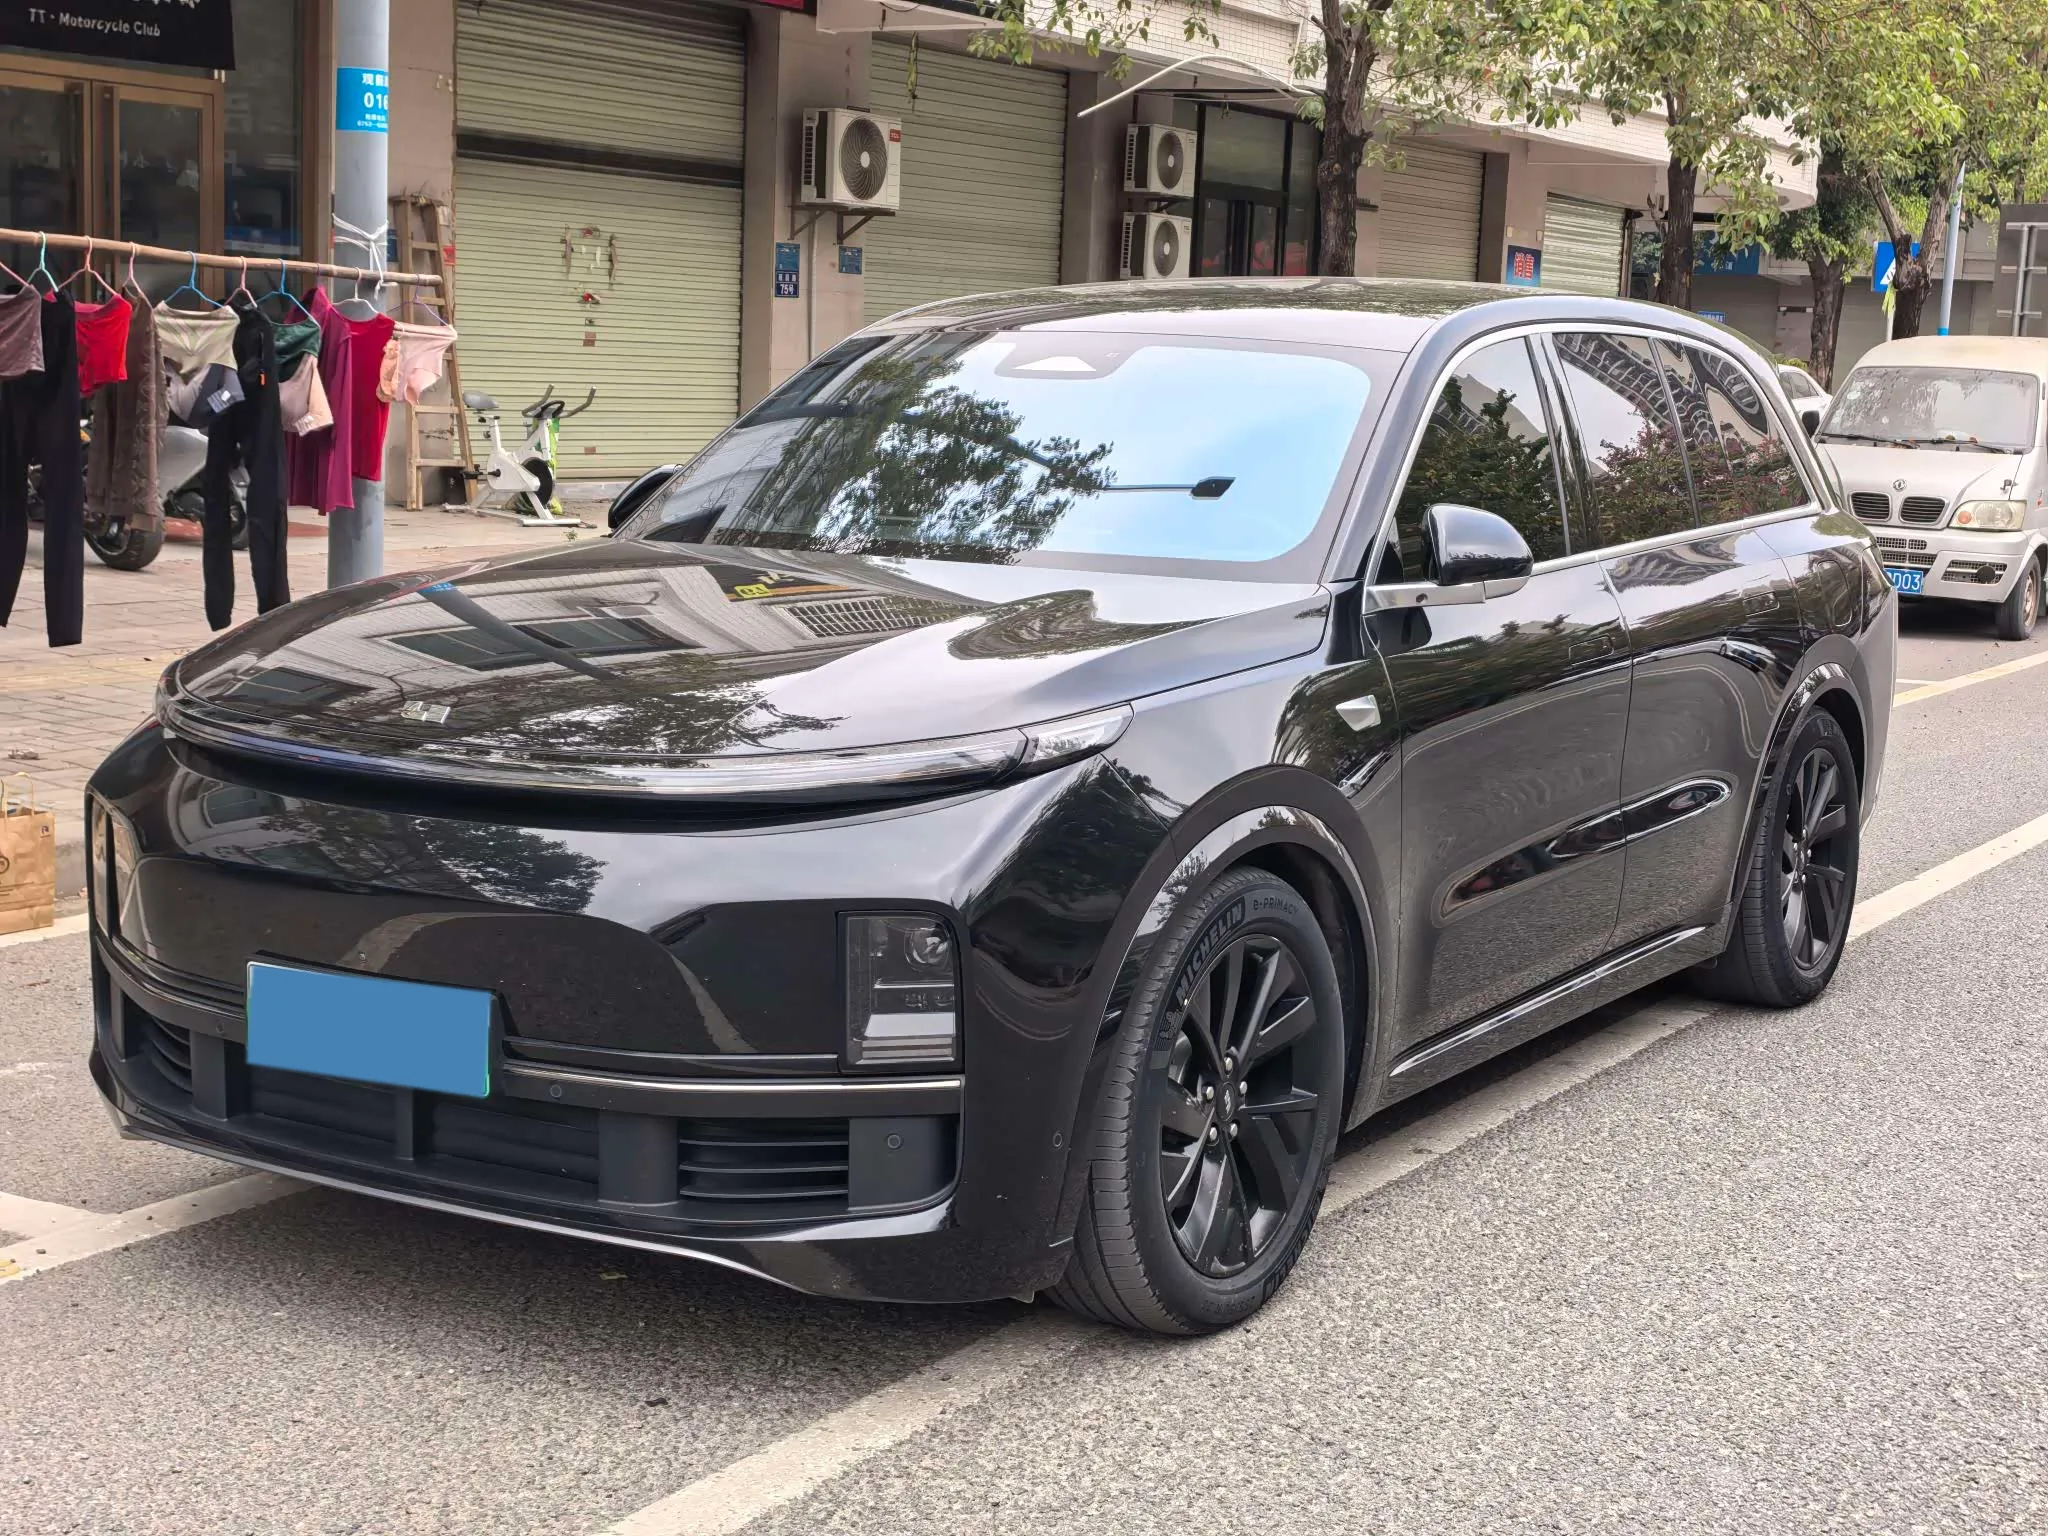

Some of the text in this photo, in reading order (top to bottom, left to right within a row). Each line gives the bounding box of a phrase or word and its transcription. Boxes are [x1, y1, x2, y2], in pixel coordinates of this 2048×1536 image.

[28, 8, 161, 37] TT Motorcycle Club
[1886, 572, 1920, 590] D03
[1176, 902, 1244, 1006] MICHELIN
